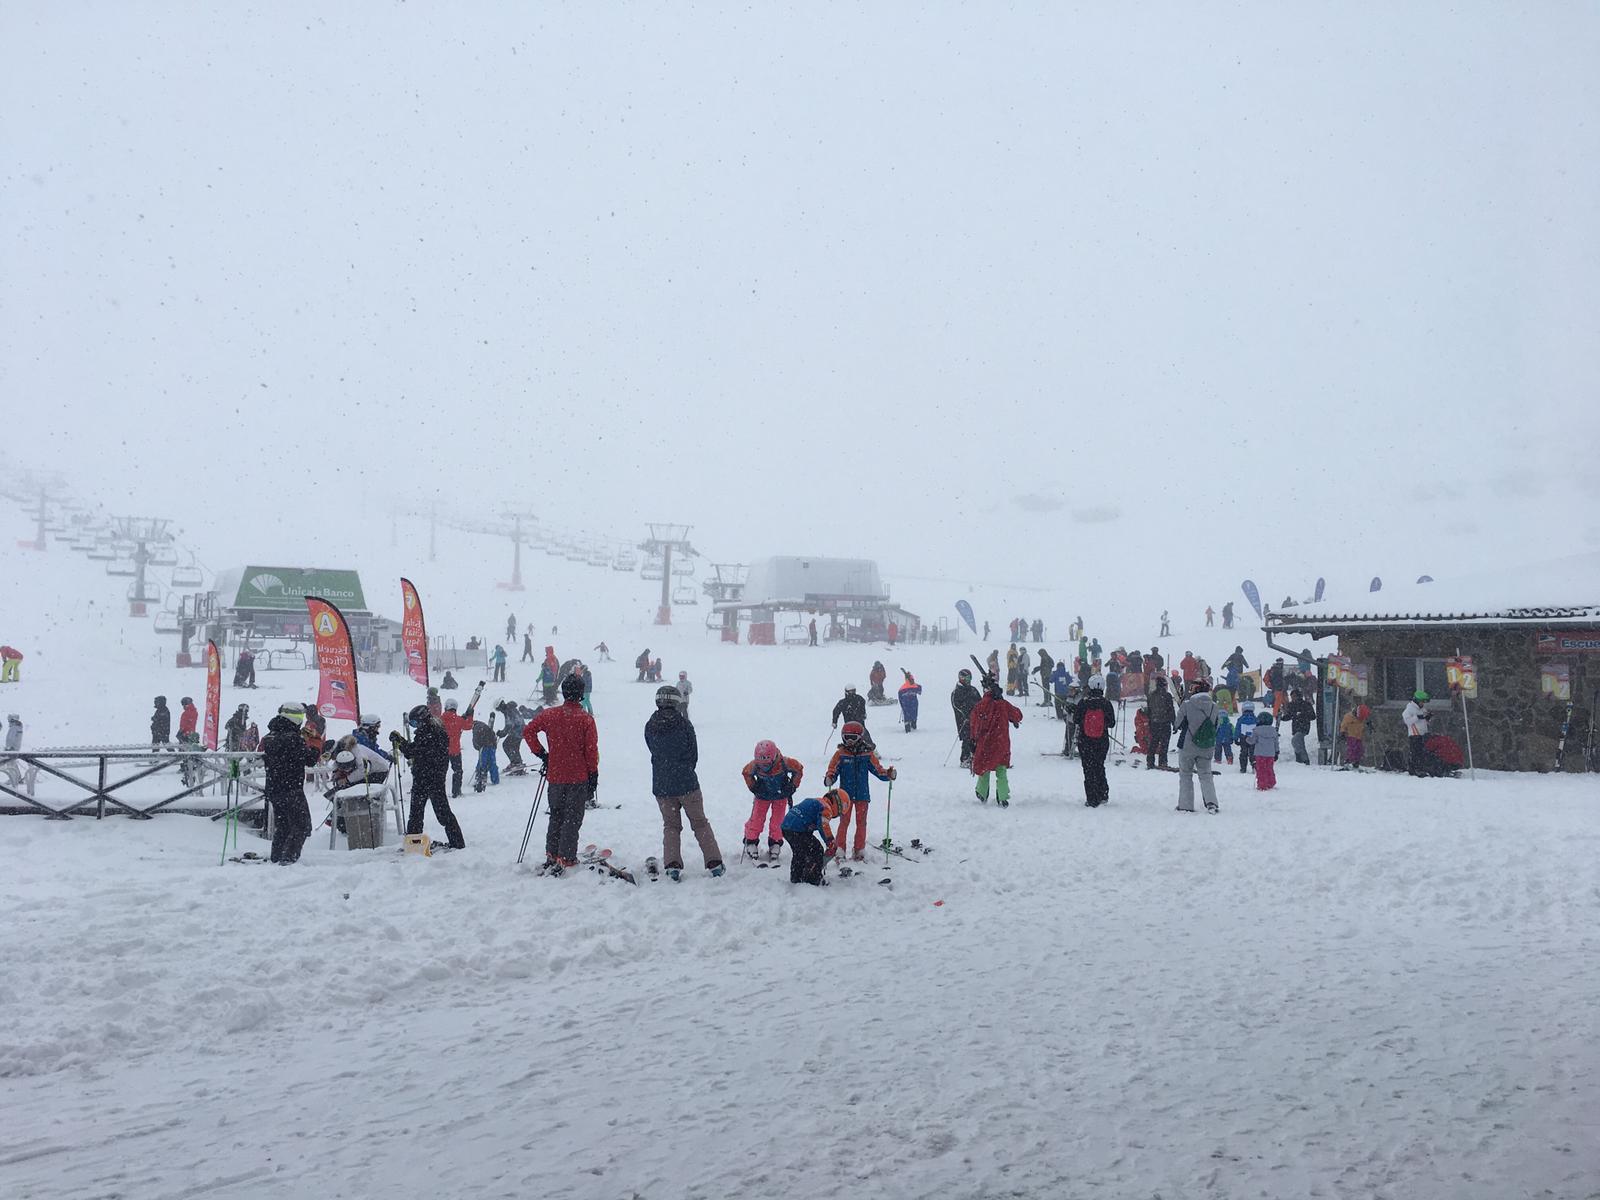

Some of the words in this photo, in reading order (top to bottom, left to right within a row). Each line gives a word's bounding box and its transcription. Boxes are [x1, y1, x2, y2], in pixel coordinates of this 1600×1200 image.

[281, 586, 321, 598] Unicaja
[322, 587, 354, 598] Banco
[319, 614, 334, 633] A
[1330, 665, 1337, 680] 3
[1339, 671, 1347, 687] 4
[1448, 667, 1457, 682] 1
[1463, 673, 1472, 688] 2
